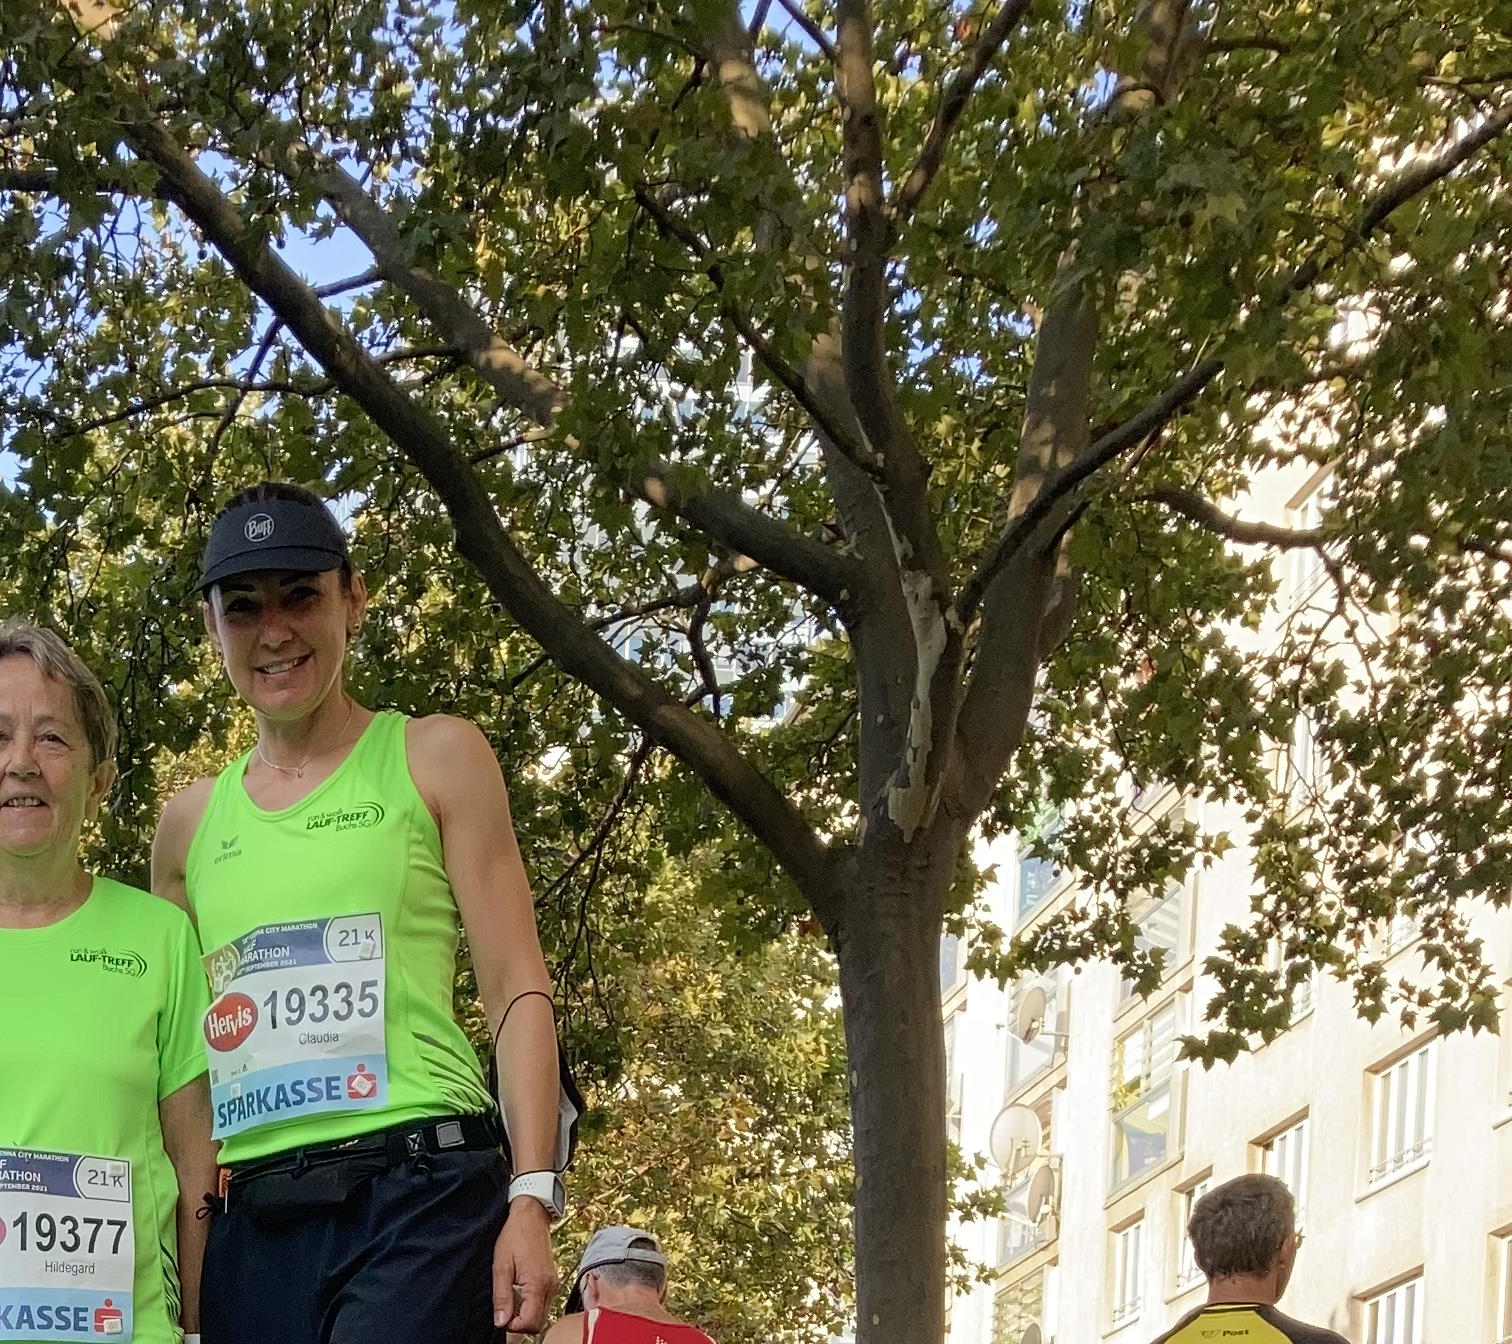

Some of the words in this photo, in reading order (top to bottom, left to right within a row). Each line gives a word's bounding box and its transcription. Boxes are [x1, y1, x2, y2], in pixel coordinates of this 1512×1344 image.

[247, 519, 271, 538] Buff
[306, 810, 369, 829] LAUF-TREFF
[70, 954, 134, 967] LAUF-TREFF
[263, 980, 379, 1029] 19335
[208, 1006, 252, 1040] Hervis
[298, 1031, 339, 1045] Claudia
[218, 1076, 342, 1128] SPARKASSE
[12, 1211, 127, 1255] 19377
[45, 1261, 95, 1276] Hildegard
